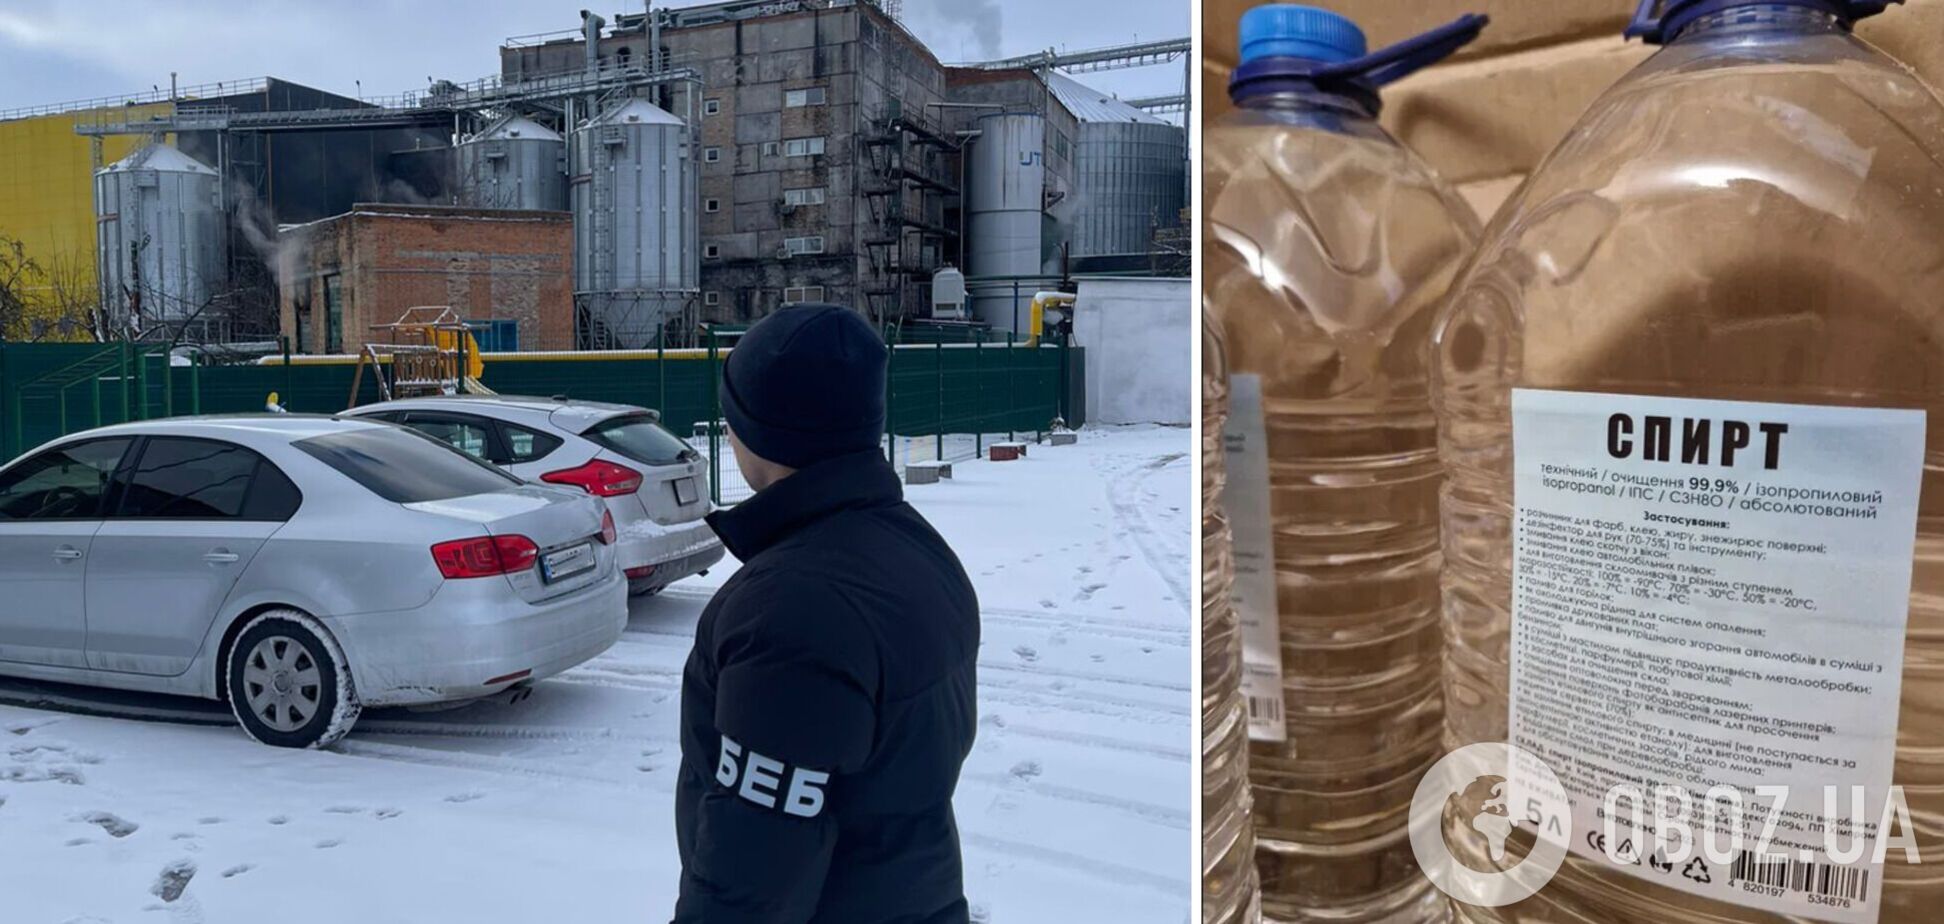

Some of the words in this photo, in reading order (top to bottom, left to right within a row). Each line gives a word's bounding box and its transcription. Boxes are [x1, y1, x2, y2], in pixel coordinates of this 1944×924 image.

[1607, 412, 1788, 470] СПИРТ
[1541, 463, 1598, 480] технічний
[1611, 472, 1685, 489] очищення
[1744, 482, 1751, 495] /
[1755, 482, 1882, 504] ізопропиловий
[1542, 475, 1616, 496] isopropanol
[1658, 490, 1665, 502] /
[1728, 496, 1735, 510] /
[1740, 498, 1877, 519] абсолютований
[1574, 518, 1590, 526] для
[1630, 526, 1661, 538] клею,
[1664, 530, 1697, 542] жиру,
[1701, 534, 1763, 549] знежирює
[1767, 541, 1827, 554] поверхні;
[1643, 510, 1730, 529] Застосування:
[1570, 537, 1594, 547] клею
[1570, 547, 1594, 558] клею
[1597, 551, 1674, 571] автомобільних
[1586, 530, 1602, 538] для
[1605, 532, 1622, 542] рук
[1626, 534, 1670, 550] (70-75%)
[1674, 542, 1686, 551] та
[1689, 544, 1766, 560] інструменту;
[1598, 570, 1622, 583] 100%
[1669, 582, 1691, 595] 70%
[1743, 592, 1766, 605] 50%
[1631, 586, 1650, 599] 10%
[1689, 576, 1729, 588] різним
[1733, 582, 1794, 596] ступенем
[1601, 602, 1636, 616] рідина
[1639, 611, 1656, 619] для
[1659, 612, 1702, 628] систем
[1705, 620, 1766, 638] опалення;
[1689, 638, 1741, 655] згорання
[1745, 647, 1817, 666] автомобілів
[1830, 658, 1873, 672] суміші
[1634, 682, 1669, 697] перед
[1649, 664, 1703, 681] побутової
[1675, 657, 1761, 681] продуктивність
[1765, 673, 1872, 695] металообробки;
[1622, 689, 1710, 714] фотобарабанів
[1713, 708, 1769, 725] лазерних
[1772, 718, 1837, 735] принтерів;
[1657, 706, 1722, 726] антисептик
[1724, 721, 1744, 730] для
[1747, 724, 1820, 742] просочення
[1677, 731, 1732, 749] медицині
[1757, 746, 1838, 766] поступається
[1842, 761, 1857, 769] за
[1684, 754, 1727, 769] рідкого
[1694, 746, 1713, 755] для
[1716, 750, 1792, 770] виготовлення
[716, 734, 830, 817] БЕБ
[1743, 882, 1785, 898] 820197
[1807, 893, 1851, 909] 534876
